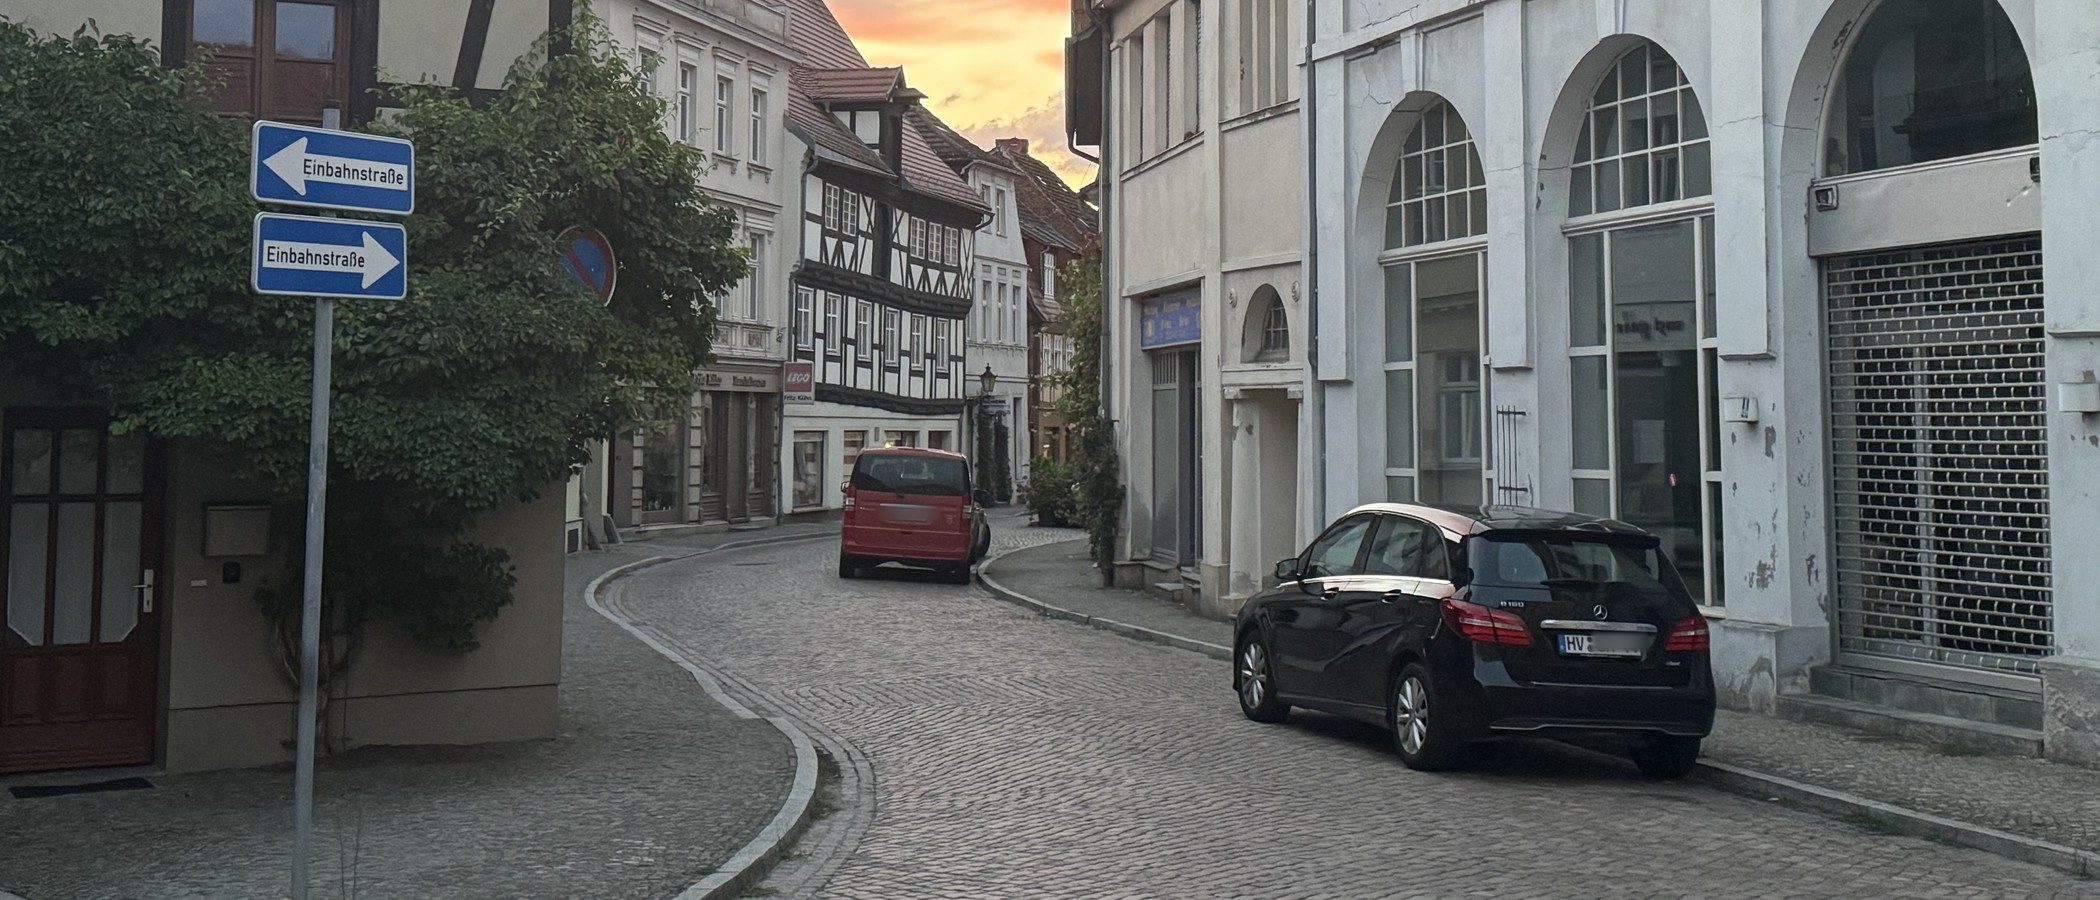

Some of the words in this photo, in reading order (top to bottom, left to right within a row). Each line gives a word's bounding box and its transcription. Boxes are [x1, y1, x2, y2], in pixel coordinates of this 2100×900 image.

[303, 158, 404, 185] Einbahnstraße
[267, 245, 365, 268] Einbahnstraße
[786, 372, 810, 383] LEGO
[1566, 635, 1585, 652] HV
